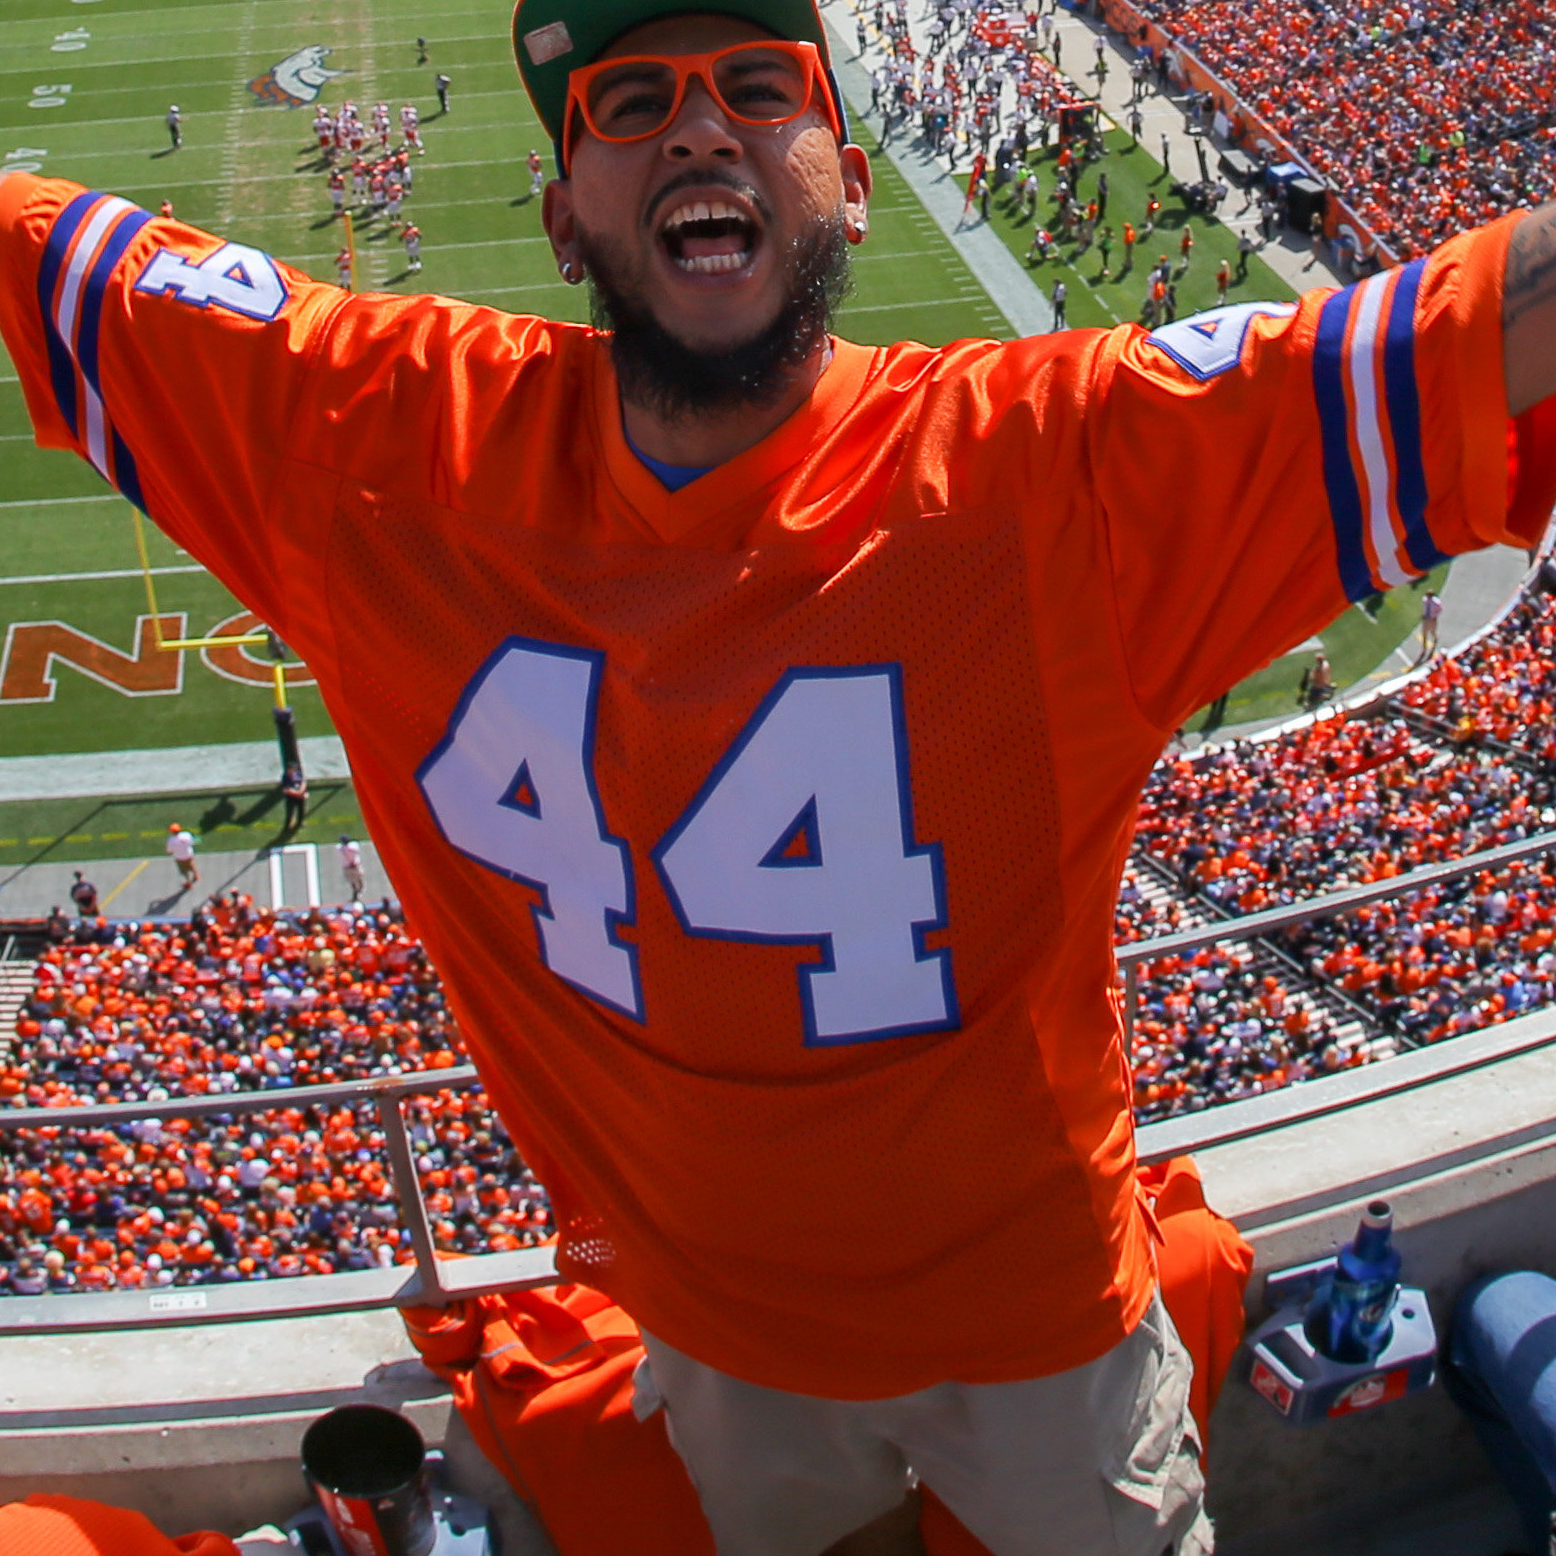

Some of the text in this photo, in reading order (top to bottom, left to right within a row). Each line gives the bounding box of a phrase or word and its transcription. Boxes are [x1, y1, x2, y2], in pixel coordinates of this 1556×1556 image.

[27, 82, 74, 108] 50
[134, 241, 290, 324] 4
[413, 634, 962, 1048] 44
